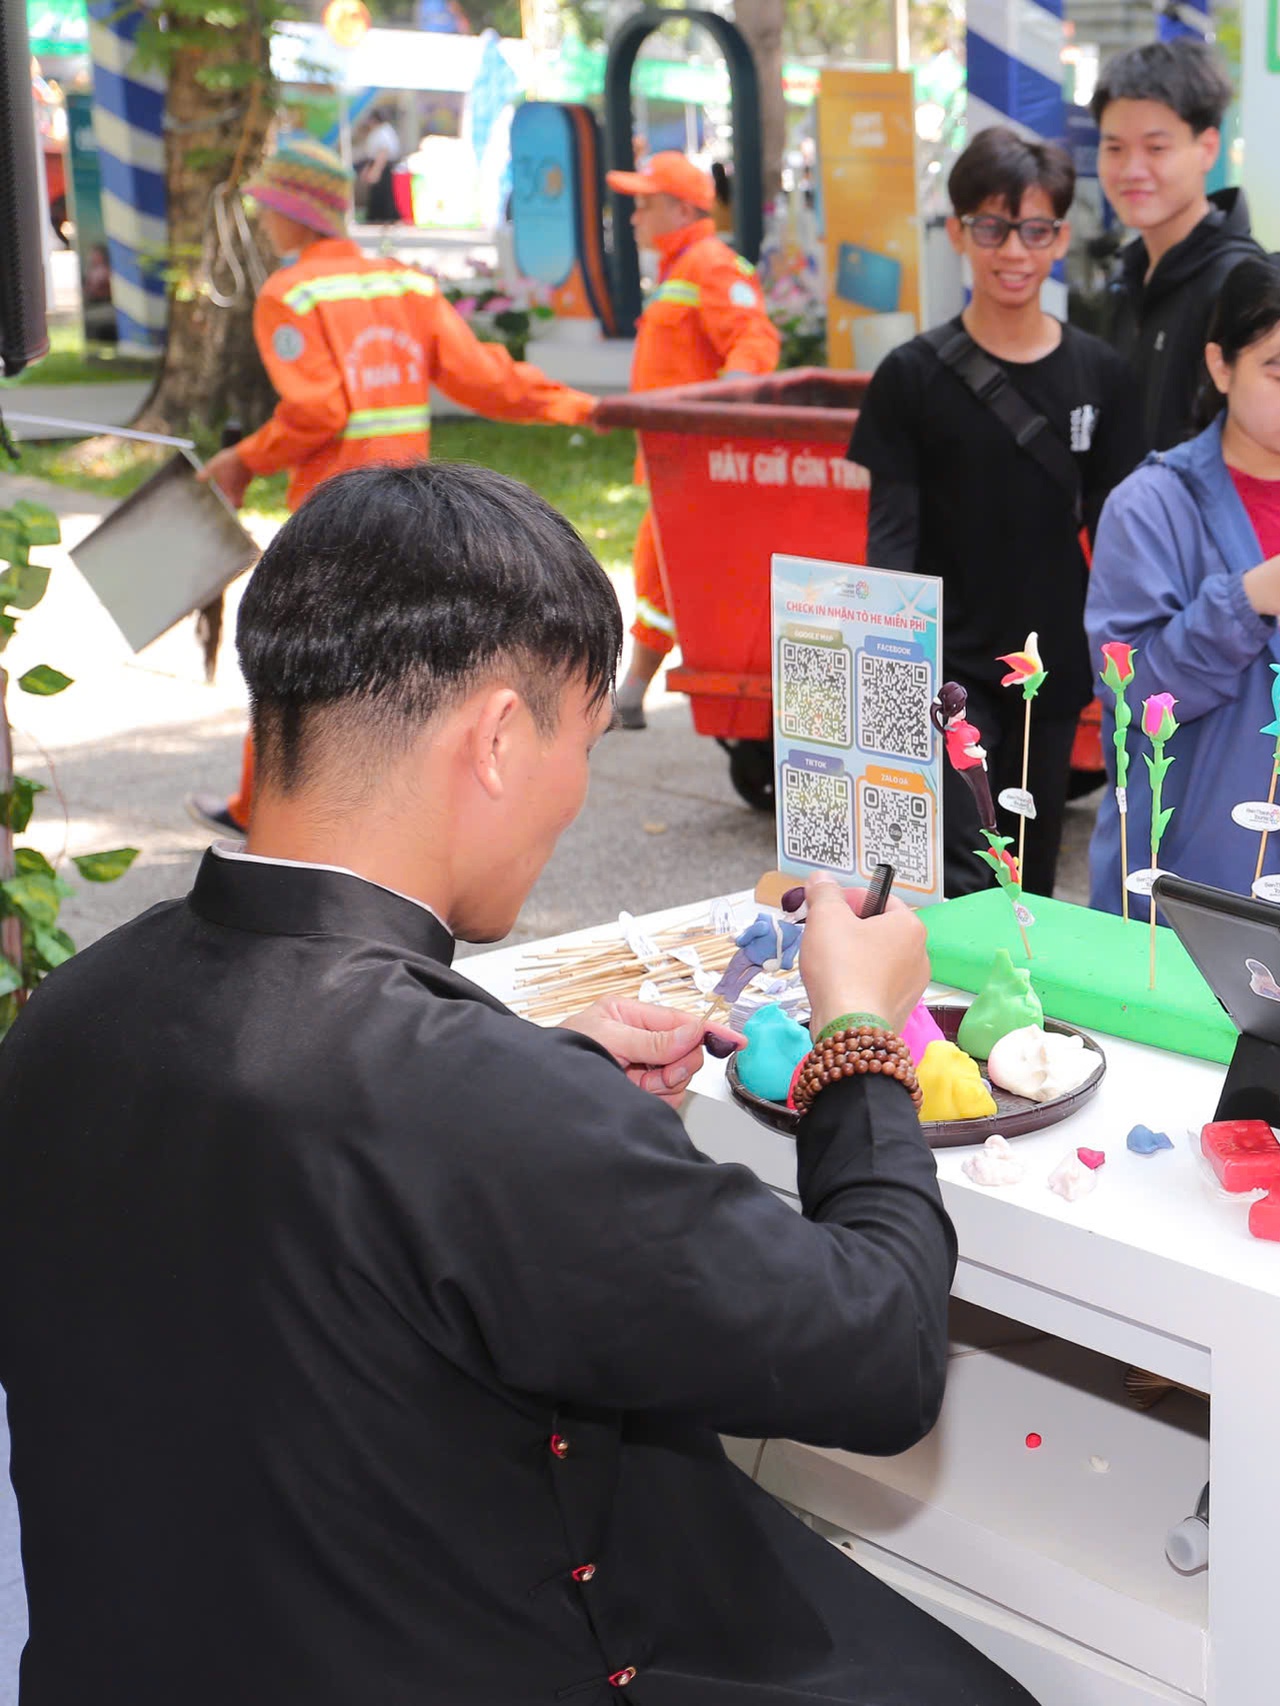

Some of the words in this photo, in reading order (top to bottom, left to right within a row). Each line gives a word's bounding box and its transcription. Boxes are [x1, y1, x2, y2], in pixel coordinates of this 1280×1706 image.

[786, 600, 814, 614] CHECK
[815, 605, 826, 616] IN
[828, 607, 855, 622] NHẬN
[856, 609, 869, 622] TÒ
[871, 615, 882, 625] HE
[910, 618, 927, 631] PHÍ
[794, 630, 818, 641] GOOGLE
[876, 643, 911, 656] FACEBOOK
[804, 757, 827, 769] TIKTOK
[881, 773, 898, 784] ZALO
